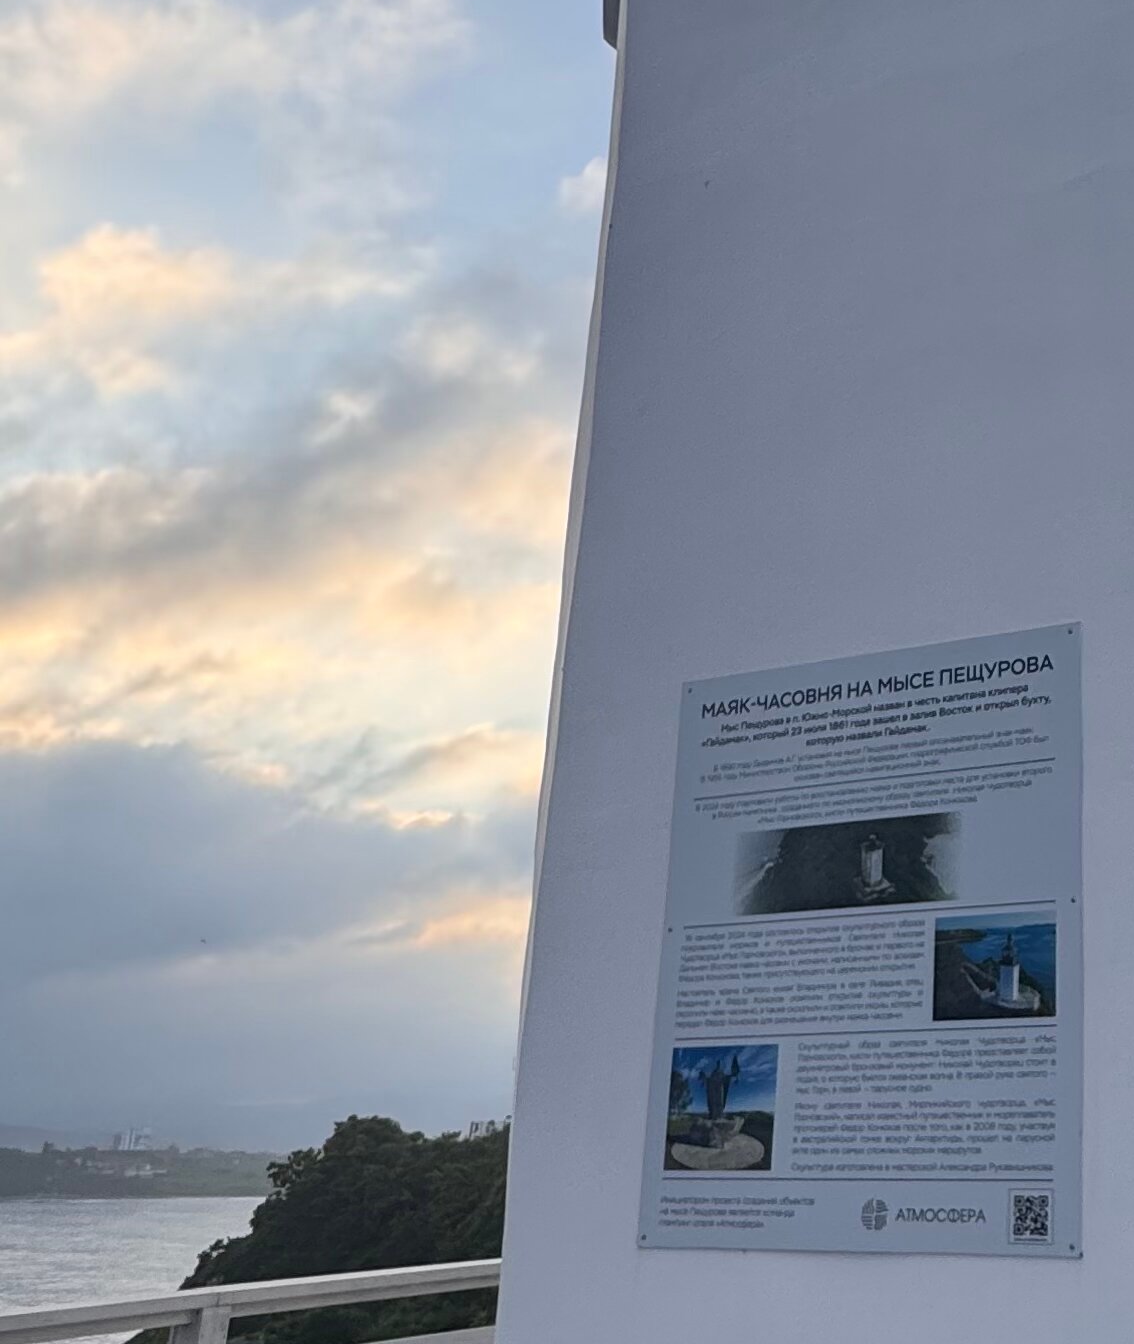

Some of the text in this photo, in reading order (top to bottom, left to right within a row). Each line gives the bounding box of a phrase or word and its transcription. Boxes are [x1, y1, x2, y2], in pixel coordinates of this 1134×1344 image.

[701, 654, 1054, 719] МАЯК-ЧАСОВНЯ НА МЫСЕ ПЕЩУРОВА
[908, 700, 912, 708] в
[915, 696, 940, 707] честь
[943, 690, 986, 703] капитана
[989, 685, 1028, 698] клипера
[753, 729, 789, 742] который
[791, 727, 802, 735] 23
[910, 710, 936, 720] залив
[939, 705, 973, 716] Восток
[976, 704, 982, 712] и
[984, 700, 1019, 712] открыл
[1022, 695, 1051, 707] бухту,
[806, 736, 844, 747] которую
[895, 1208, 987, 1223] АТМОСФЕРА
